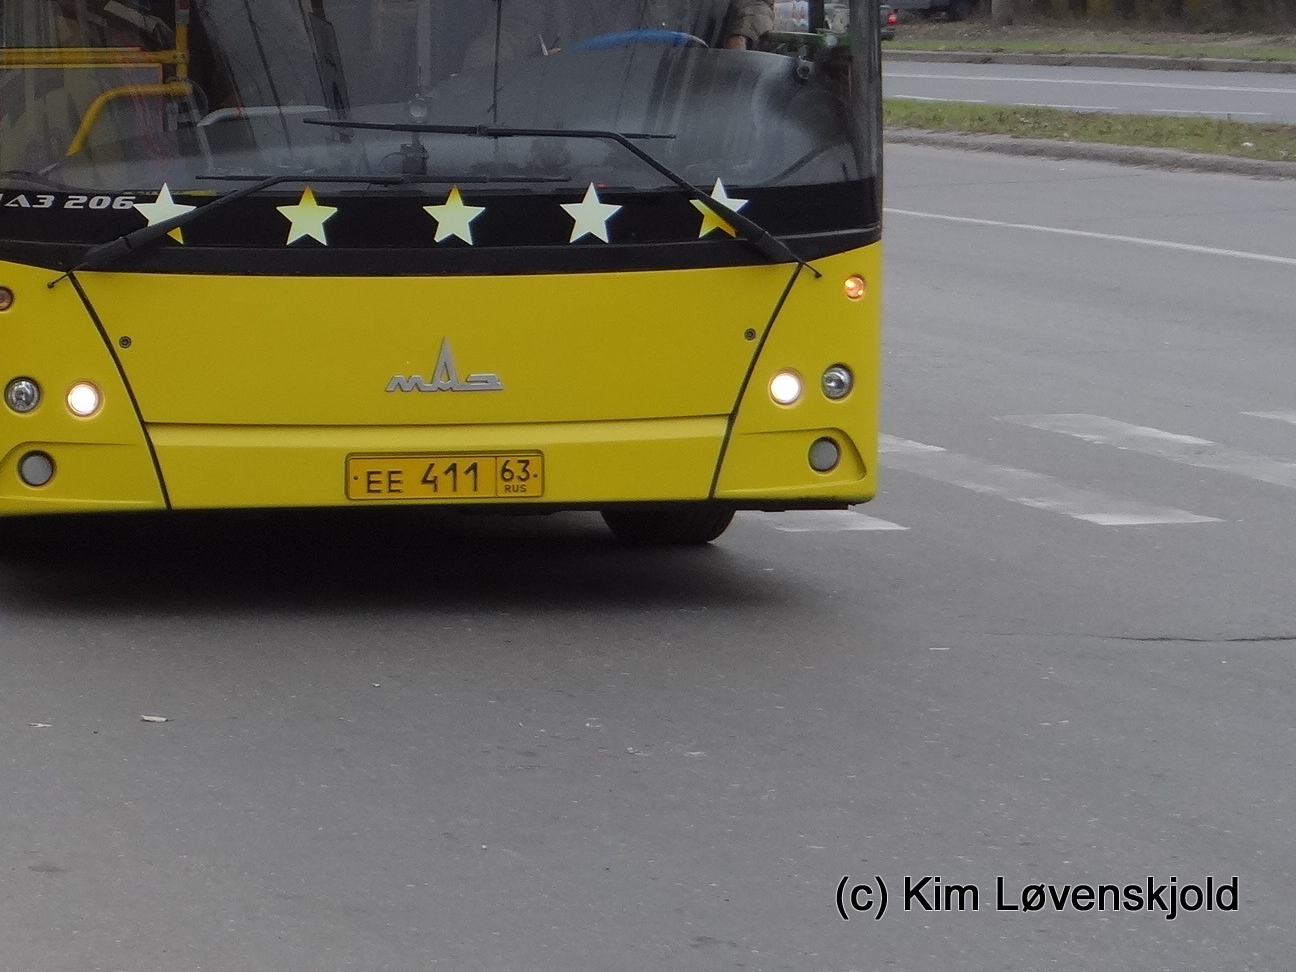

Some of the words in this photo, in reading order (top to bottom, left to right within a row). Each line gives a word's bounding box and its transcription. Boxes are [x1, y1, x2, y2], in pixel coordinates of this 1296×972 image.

[64, 195, 136, 210] 206
[366, 470, 403, 494] ЕЕ
[420, 462, 479, 494] 411
[500, 459, 530, 483] 63
[504, 484, 528, 494] RUS
